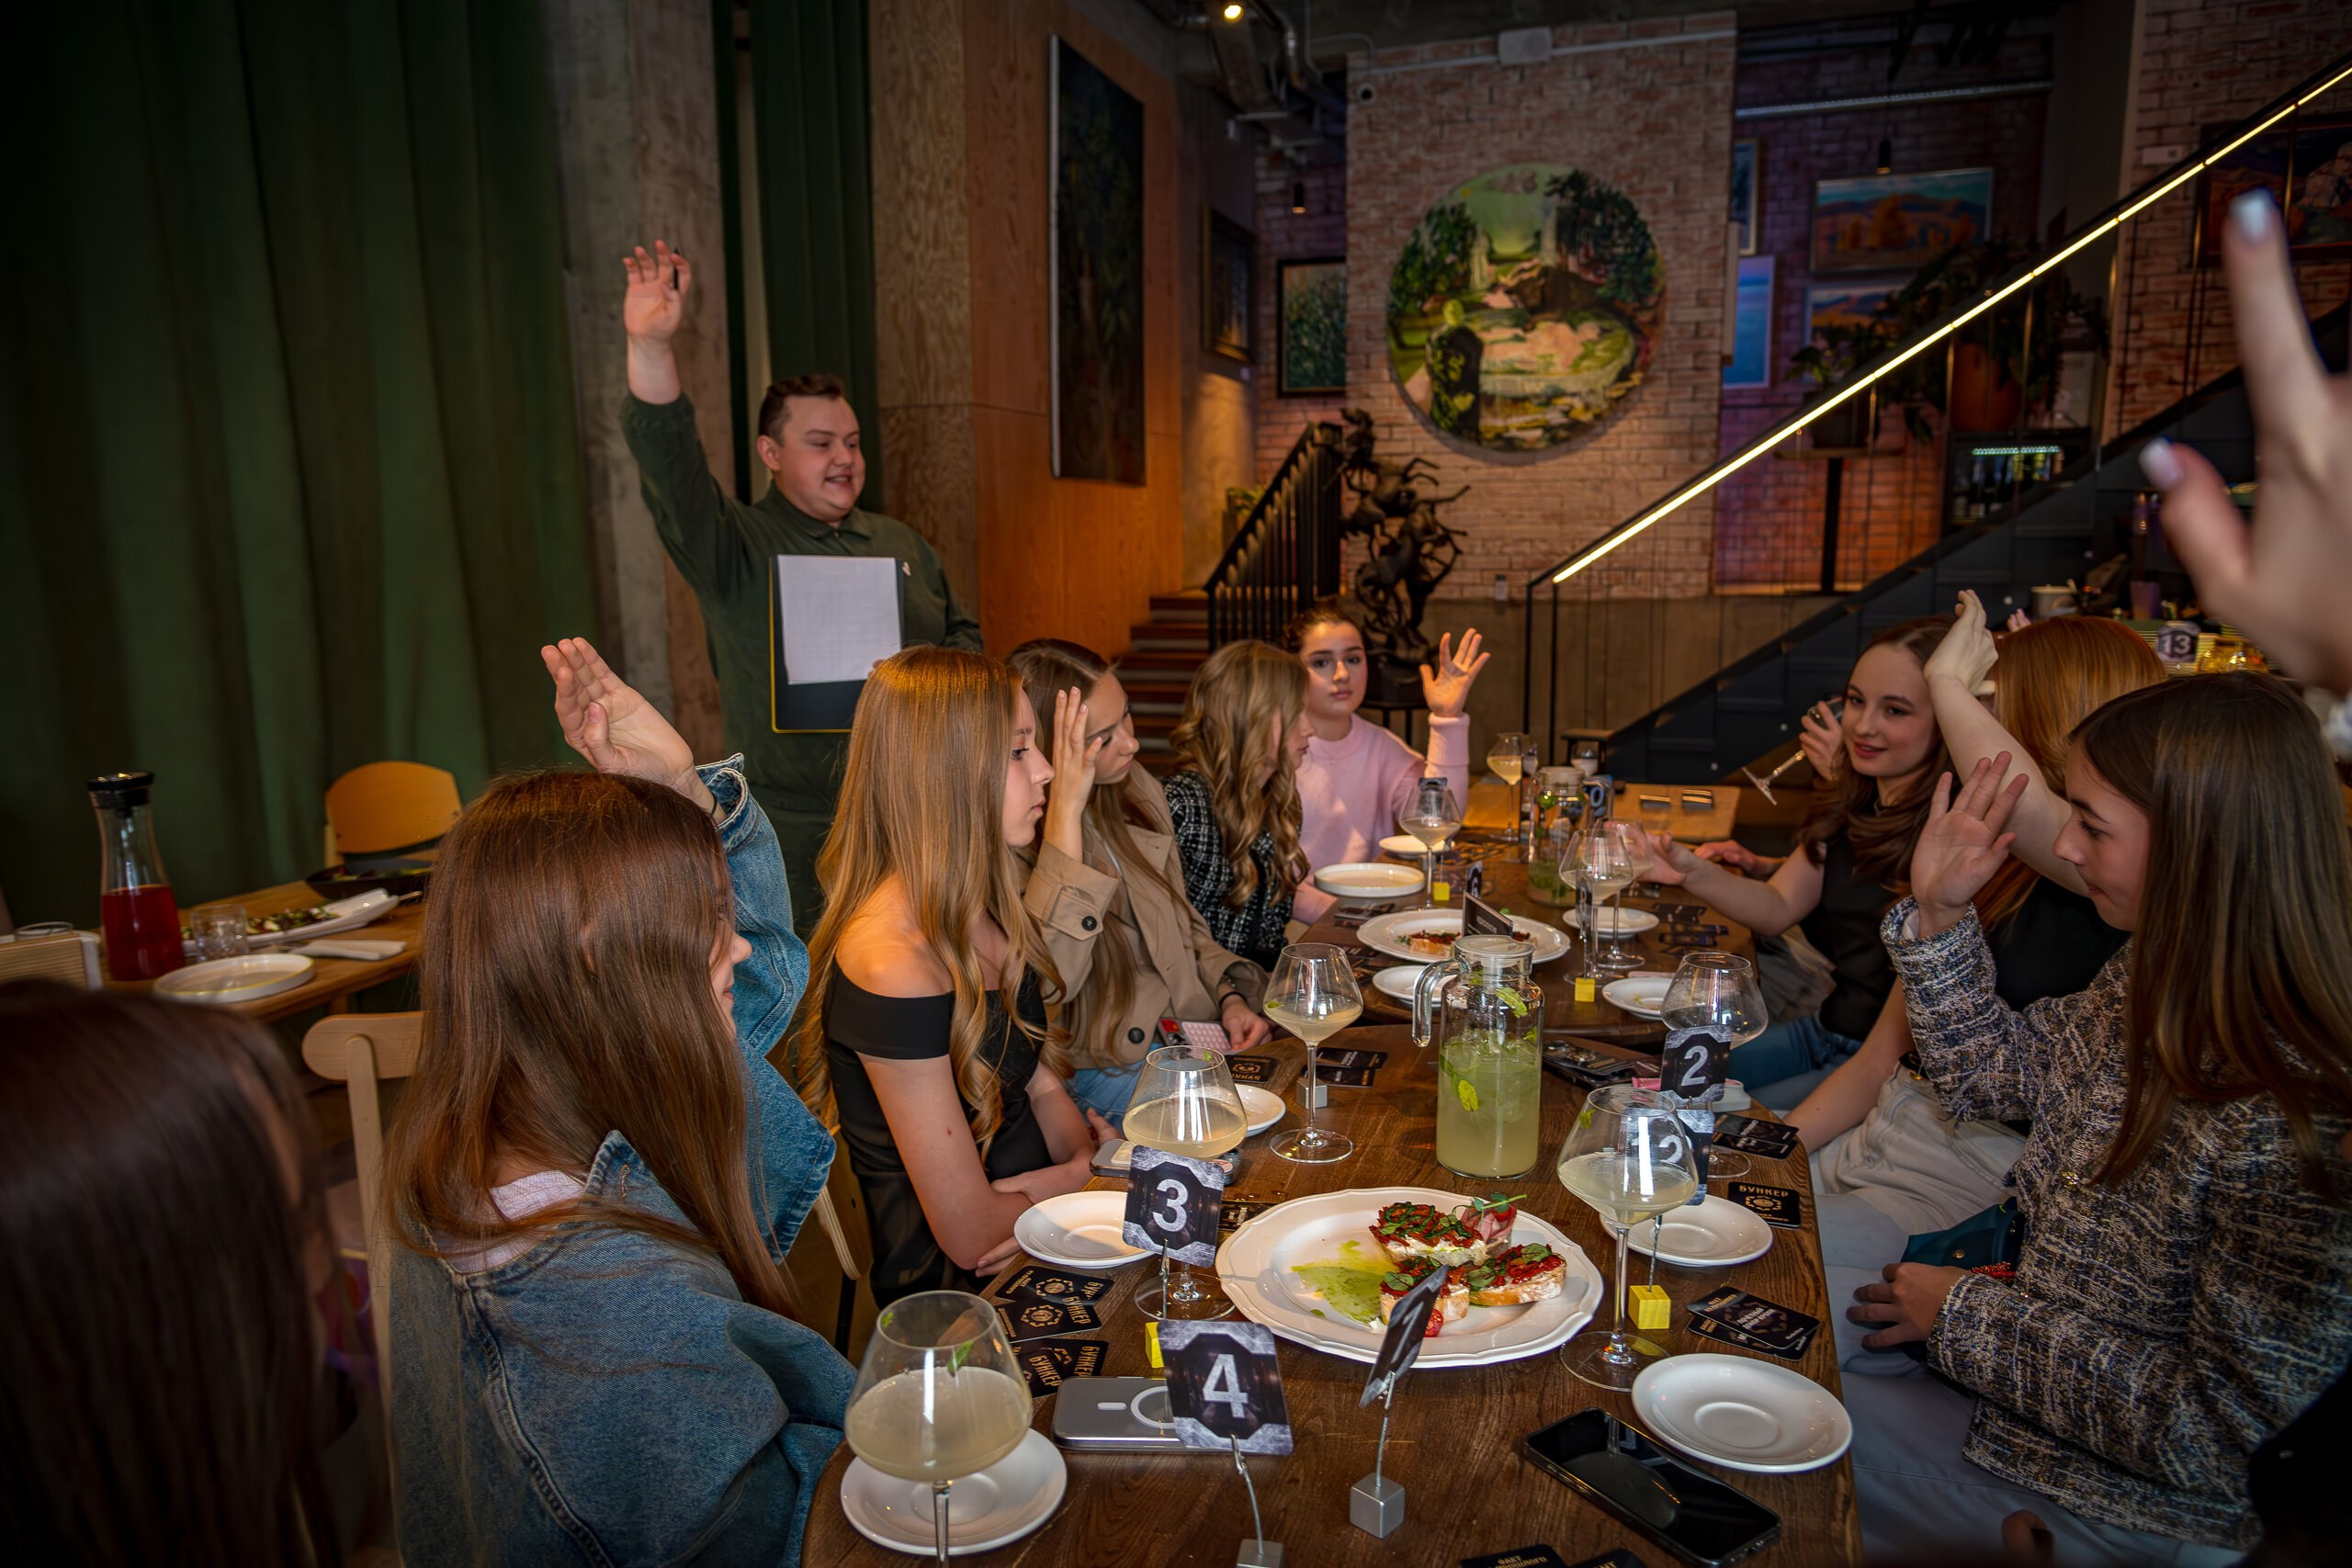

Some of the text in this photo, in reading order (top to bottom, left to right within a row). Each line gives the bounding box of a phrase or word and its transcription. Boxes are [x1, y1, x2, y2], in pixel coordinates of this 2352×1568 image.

[2161, 634, 2191, 654] 13
[1680, 1045, 1708, 1087] 2
[1152, 1179, 1189, 1232] 3
[1738, 1185, 1789, 1198] БУНКЕР
[1081, 1280, 1104, 1300] БУН
[1062, 1296, 1091, 1325] БУНКЕР
[1391, 1301, 1424, 1364] 1
[1029, 1355, 1063, 1387] БУНКЕР
[1202, 1353, 1248, 1418] 4
